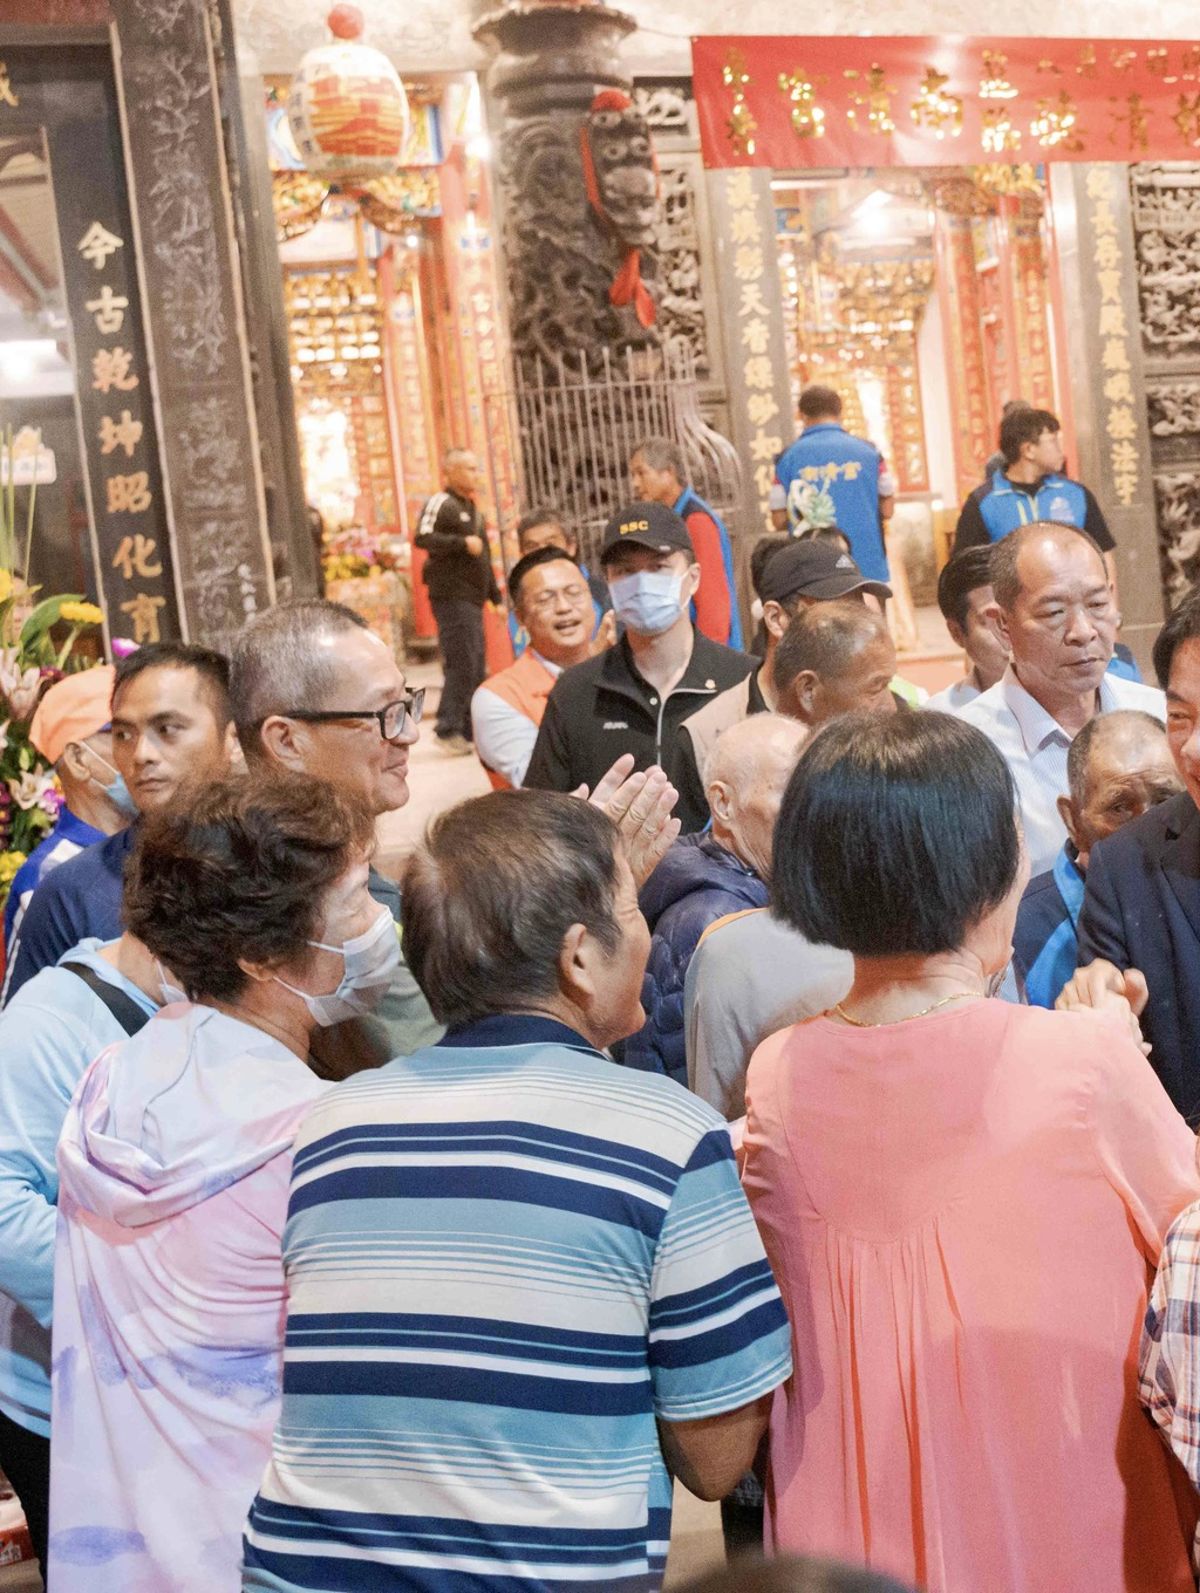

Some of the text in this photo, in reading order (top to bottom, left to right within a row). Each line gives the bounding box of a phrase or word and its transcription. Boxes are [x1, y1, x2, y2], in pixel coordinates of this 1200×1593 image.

[78, 221, 167, 644] 今古乾坤昭化育
[619, 519, 649, 536] SSC
